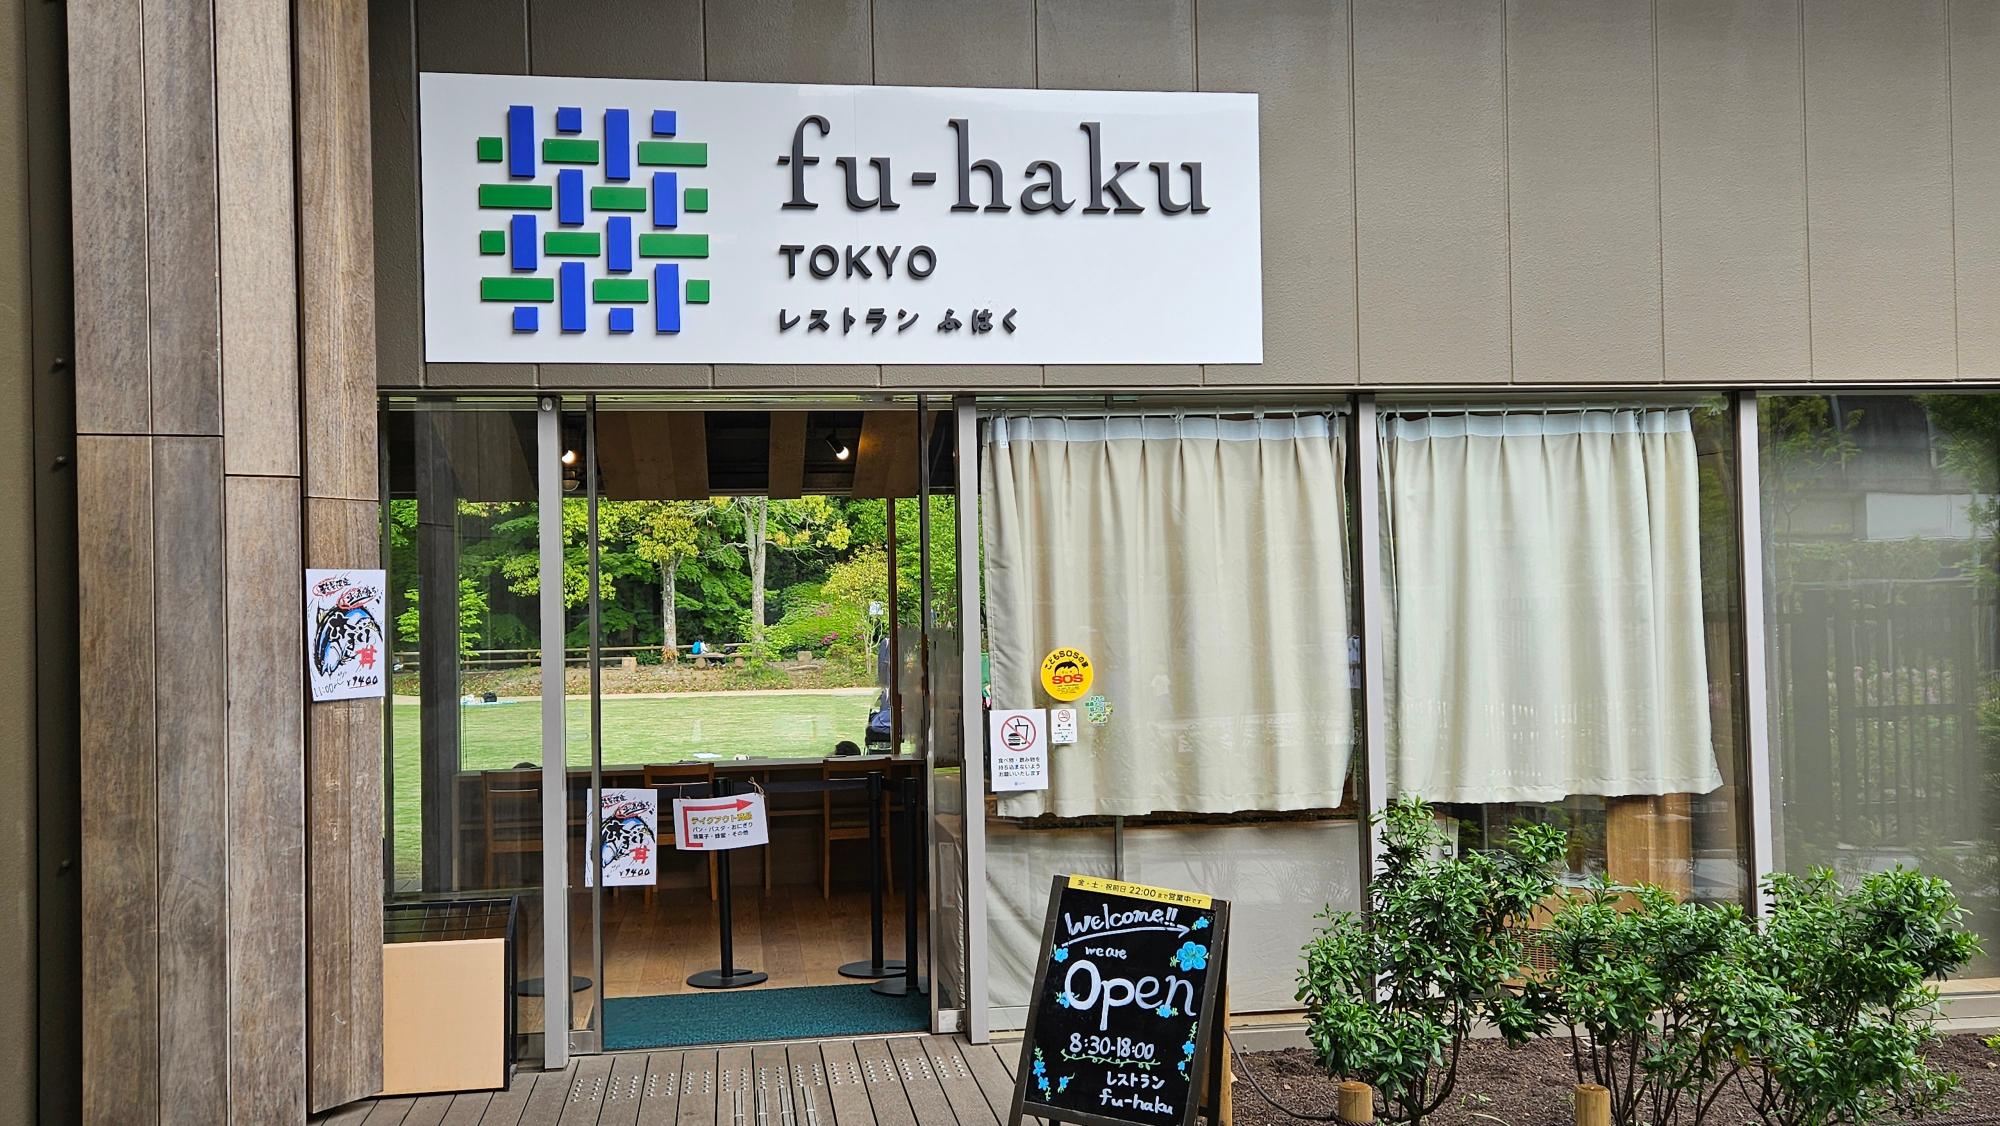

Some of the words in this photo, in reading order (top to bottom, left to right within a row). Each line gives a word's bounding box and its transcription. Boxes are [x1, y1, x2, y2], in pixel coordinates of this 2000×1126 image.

[777, 114, 1211, 215] fu-haku
[778, 244, 937, 279] TOKYO
[779, 307, 919, 335] レストラン
[937, 307, 1017, 335] ふはく
[1052, 674, 1083, 684] SOS
[1129, 886, 1157, 897] 22:00
[1105, 947, 1127, 959] are
[1064, 959, 1197, 1031] Open
[1070, 1033, 1155, 1059] 8:30-18:00
[1106, 1071, 1166, 1089] レストラン
[1099, 1089, 1174, 1115] fu-haku
